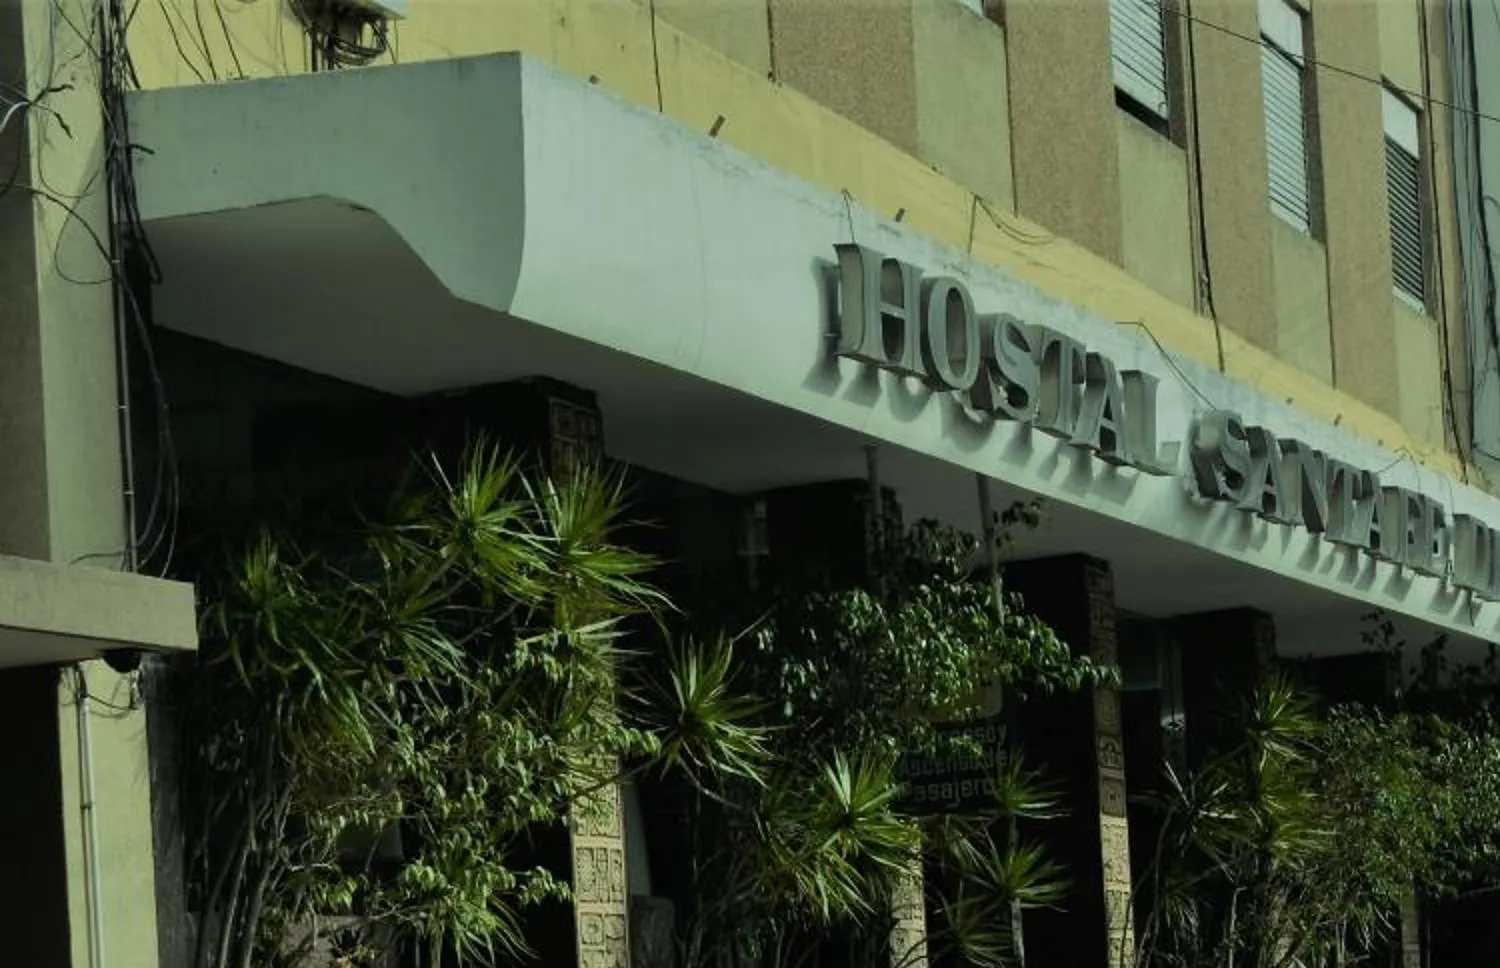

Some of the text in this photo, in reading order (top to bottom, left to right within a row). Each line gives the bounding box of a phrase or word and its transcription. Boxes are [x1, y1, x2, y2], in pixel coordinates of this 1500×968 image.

[832, 242, 1182, 478] HOSTAL
[1188, 410, 1384, 555] SANTA
[1380, 485, 1450, 580] FE
